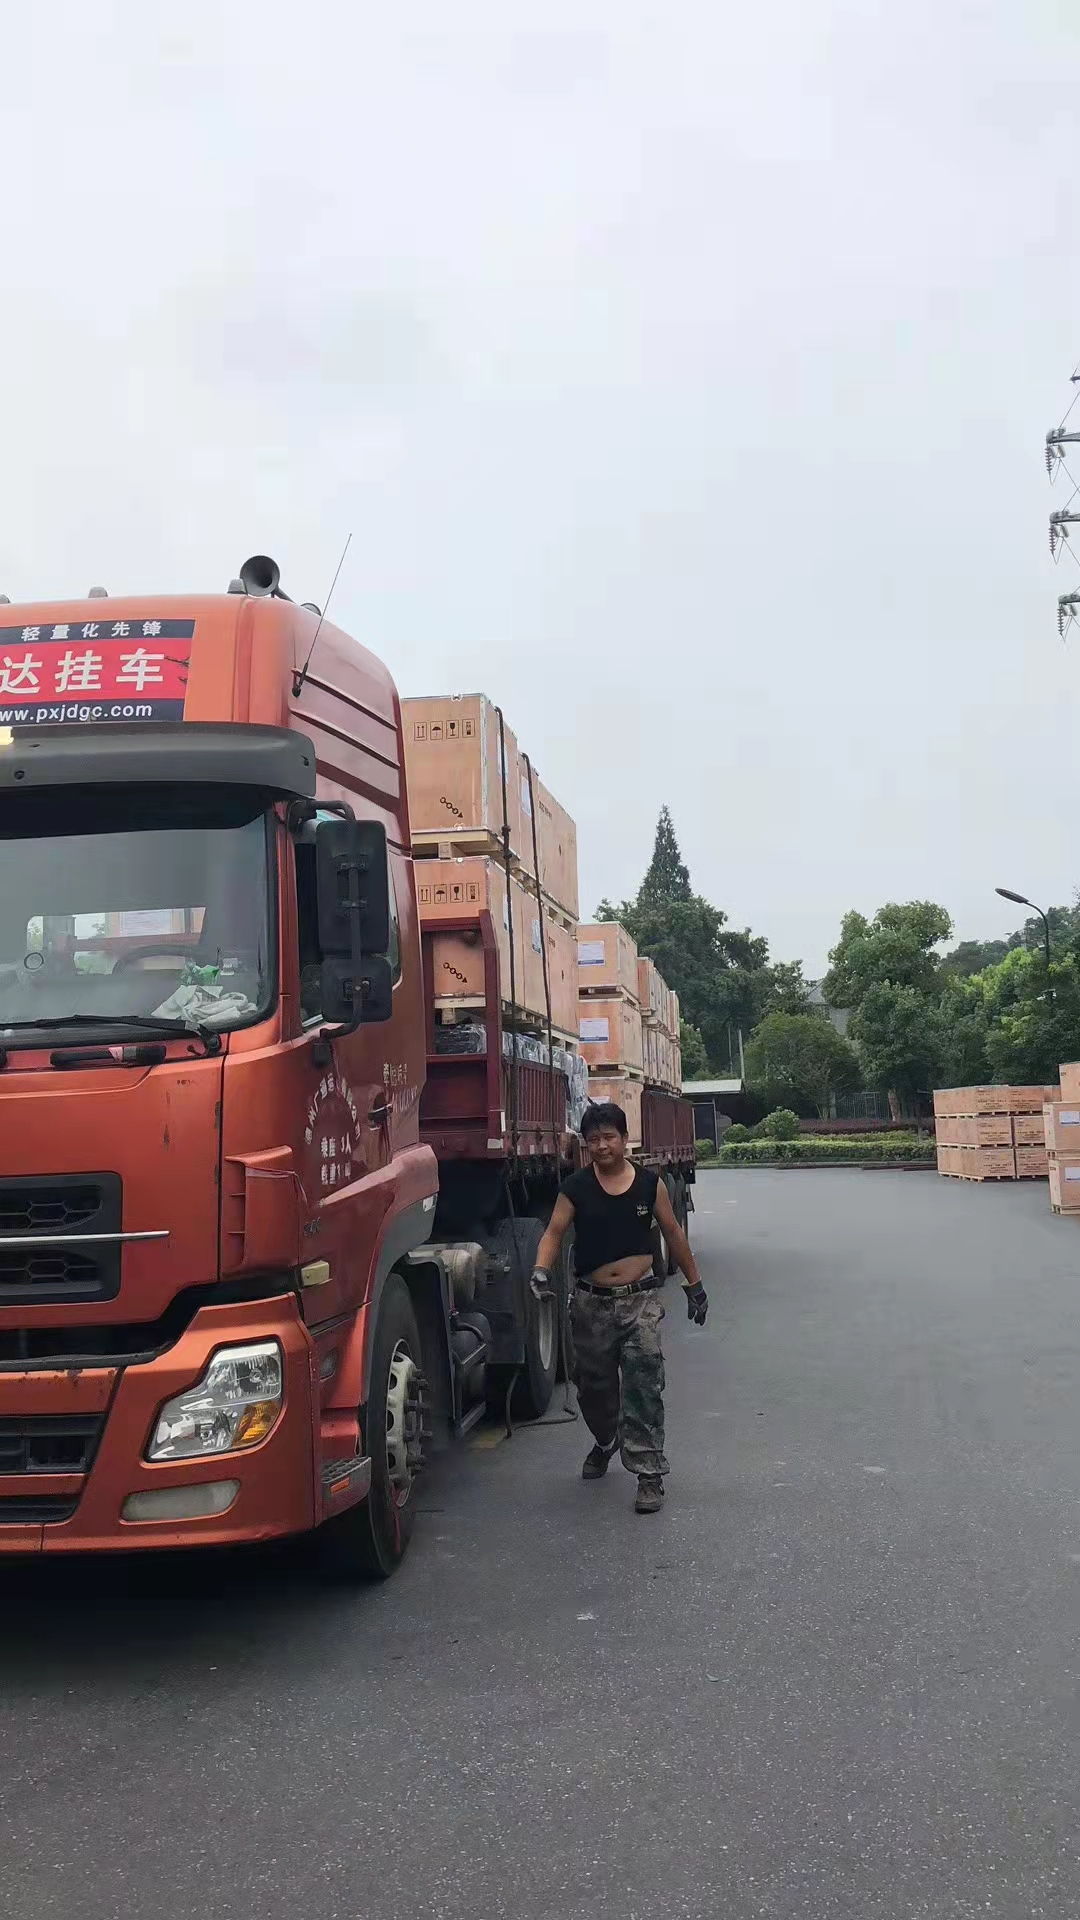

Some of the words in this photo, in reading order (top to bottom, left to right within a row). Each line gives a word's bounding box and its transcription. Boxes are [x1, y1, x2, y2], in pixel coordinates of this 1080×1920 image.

[21, 620, 162, 642] 轻量化先锋
[0, 647, 165, 694] 达挂车
